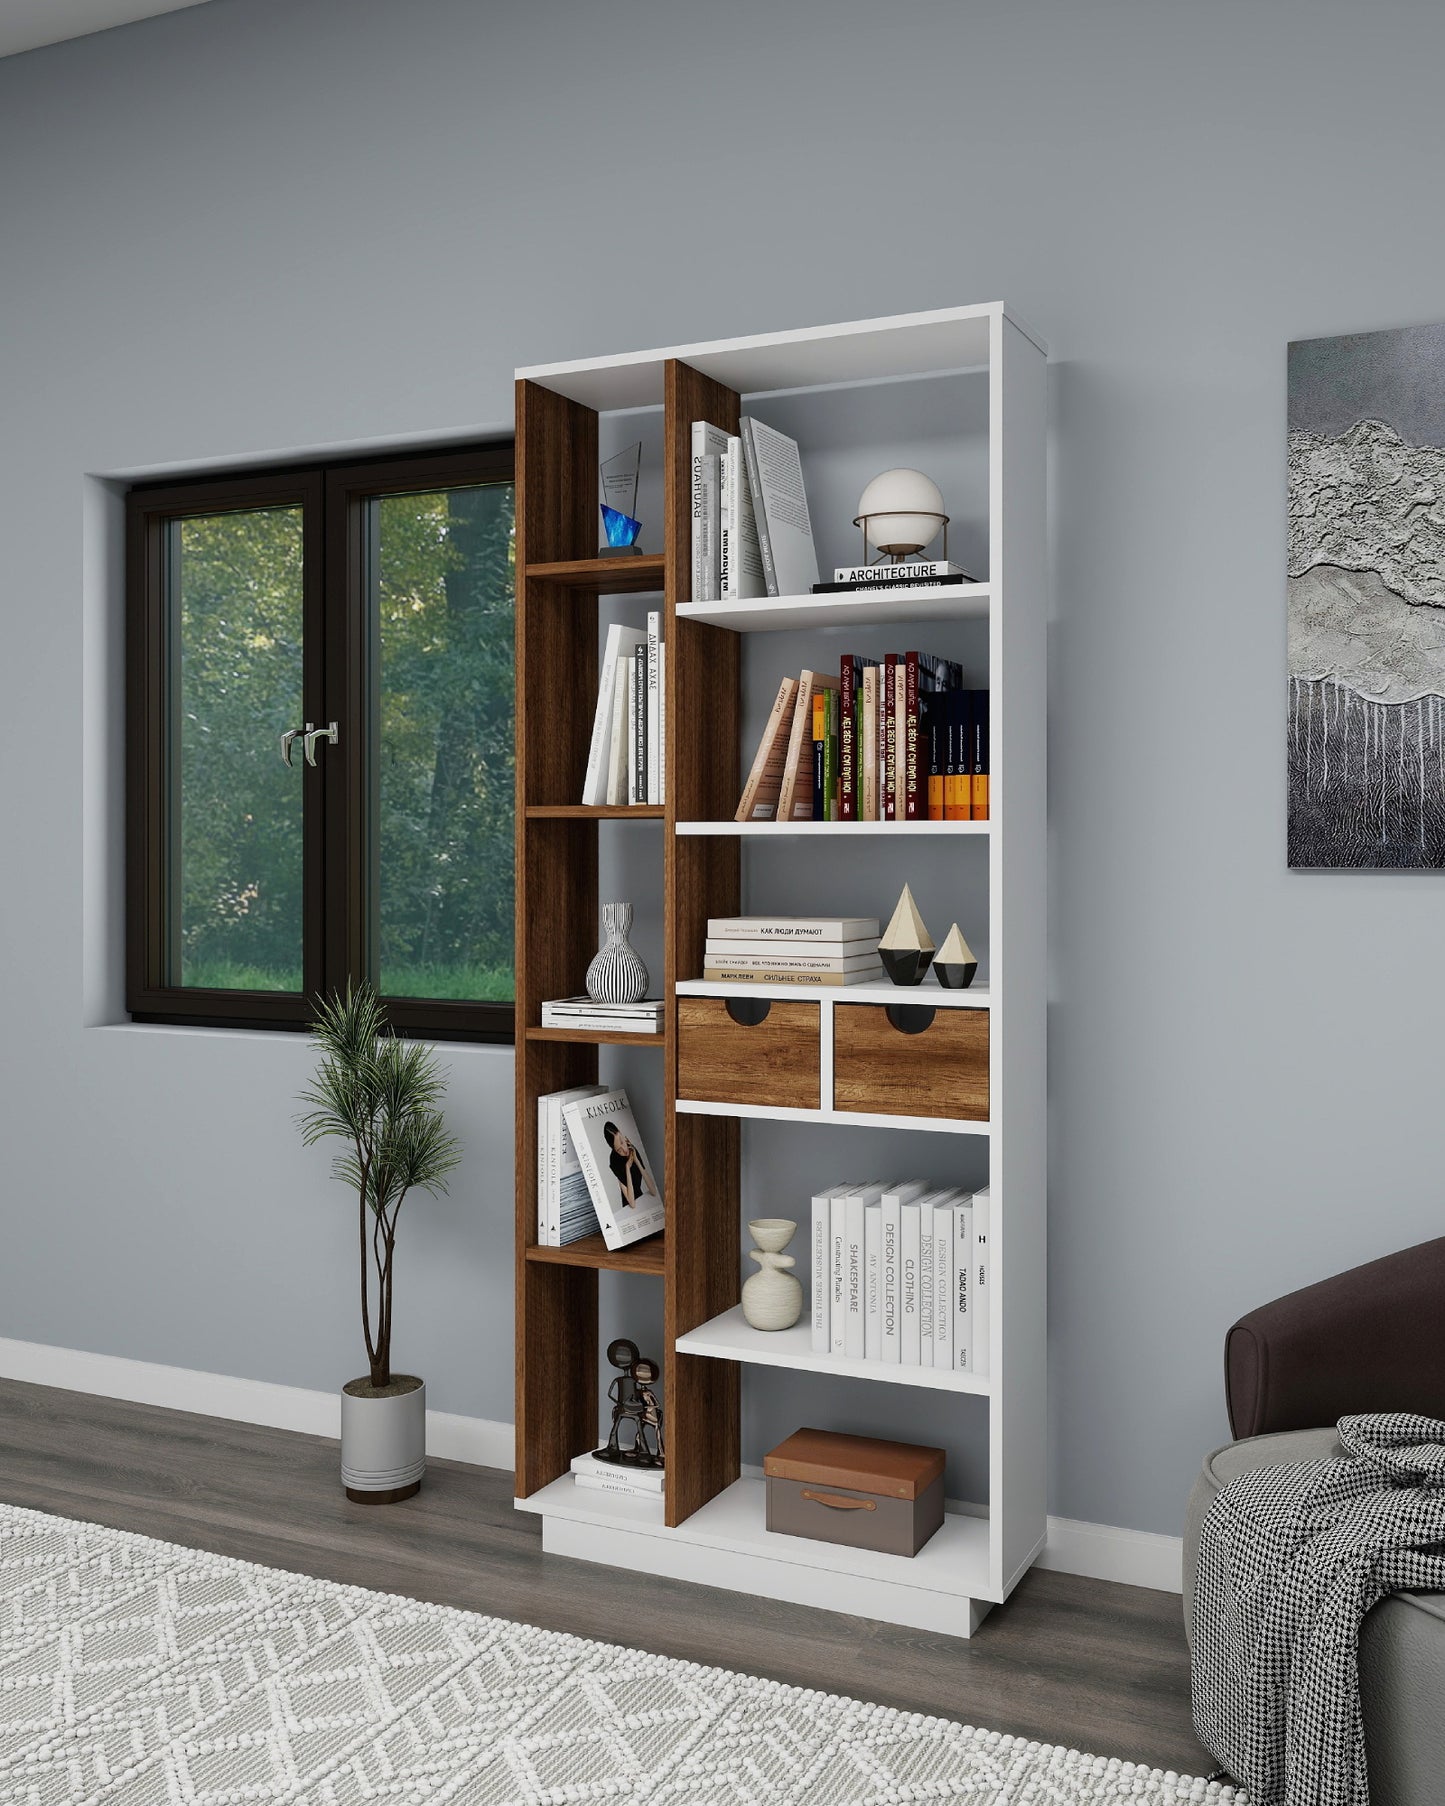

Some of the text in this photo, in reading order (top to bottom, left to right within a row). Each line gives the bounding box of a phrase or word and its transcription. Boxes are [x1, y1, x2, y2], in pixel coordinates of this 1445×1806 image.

[850, 564, 937, 582] ARCHITECTURE
[760, 927, 824, 937] КАК ЛЮДИ ДУМАЮТ
[764, 974, 822, 983] СИЛЬНЕЕ СТРАХА
[585, 1098, 628, 1119] KINFOLK
[979, 1235, 986, 1244] H
[815, 1220, 823, 1329] THE THREE MUSKETEERS
[849, 1244, 858, 1313] SHAKESPEARE
[885, 1223, 895, 1336] DESIGN COLLECTION
[905, 1259, 914, 1314] CLOTHING
[921, 1234, 932, 1338] DESIGN COLLECTION
[938, 1239, 947, 1341] DESIGN COLLECTION
[959, 1268, 967, 1313] TADAO ANDO
